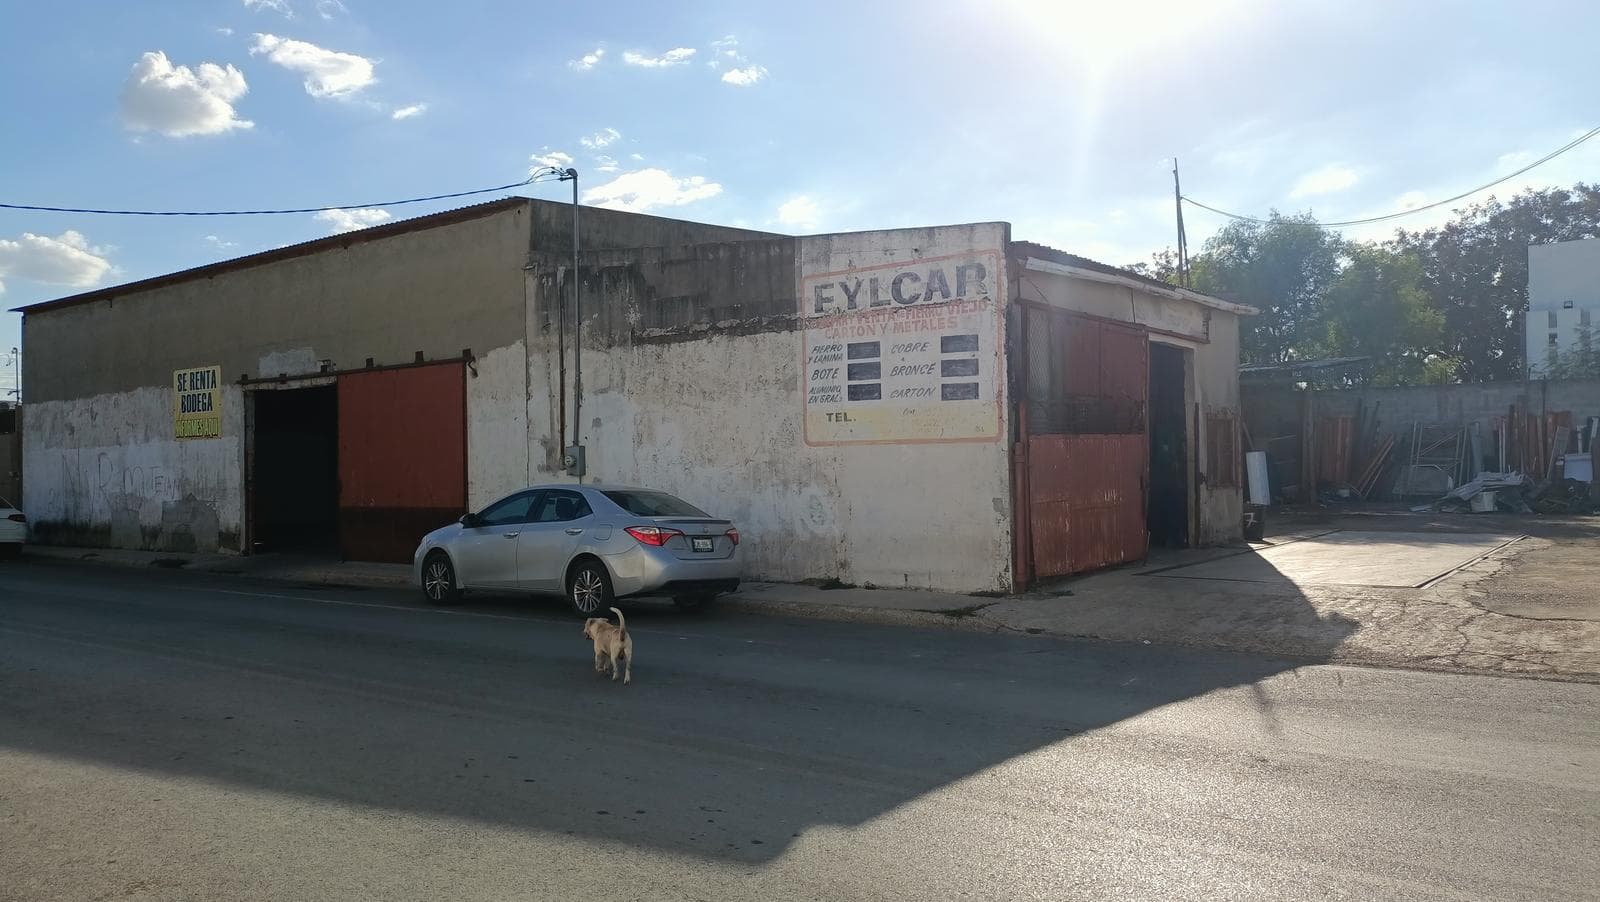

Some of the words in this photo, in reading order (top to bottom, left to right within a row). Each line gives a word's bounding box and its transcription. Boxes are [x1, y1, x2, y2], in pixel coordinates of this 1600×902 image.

[825, 323, 876, 340] CARTON
[880, 322, 889, 335] Y
[893, 316, 958, 334] METALES
[811, 344, 843, 354] FIERRO
[890, 342, 930, 354] COBRE
[814, 353, 843, 363] LAMINA
[811, 368, 839, 381] BOTE
[890, 362, 937, 377] BRONCE
[177, 373, 187, 392] SE
[189, 369, 217, 391] RENTA
[890, 386, 937, 399] CARTON
[181, 392, 213, 414] BODEGA
[808, 395, 819, 404] EN
[825, 412, 857, 423] TEL.
